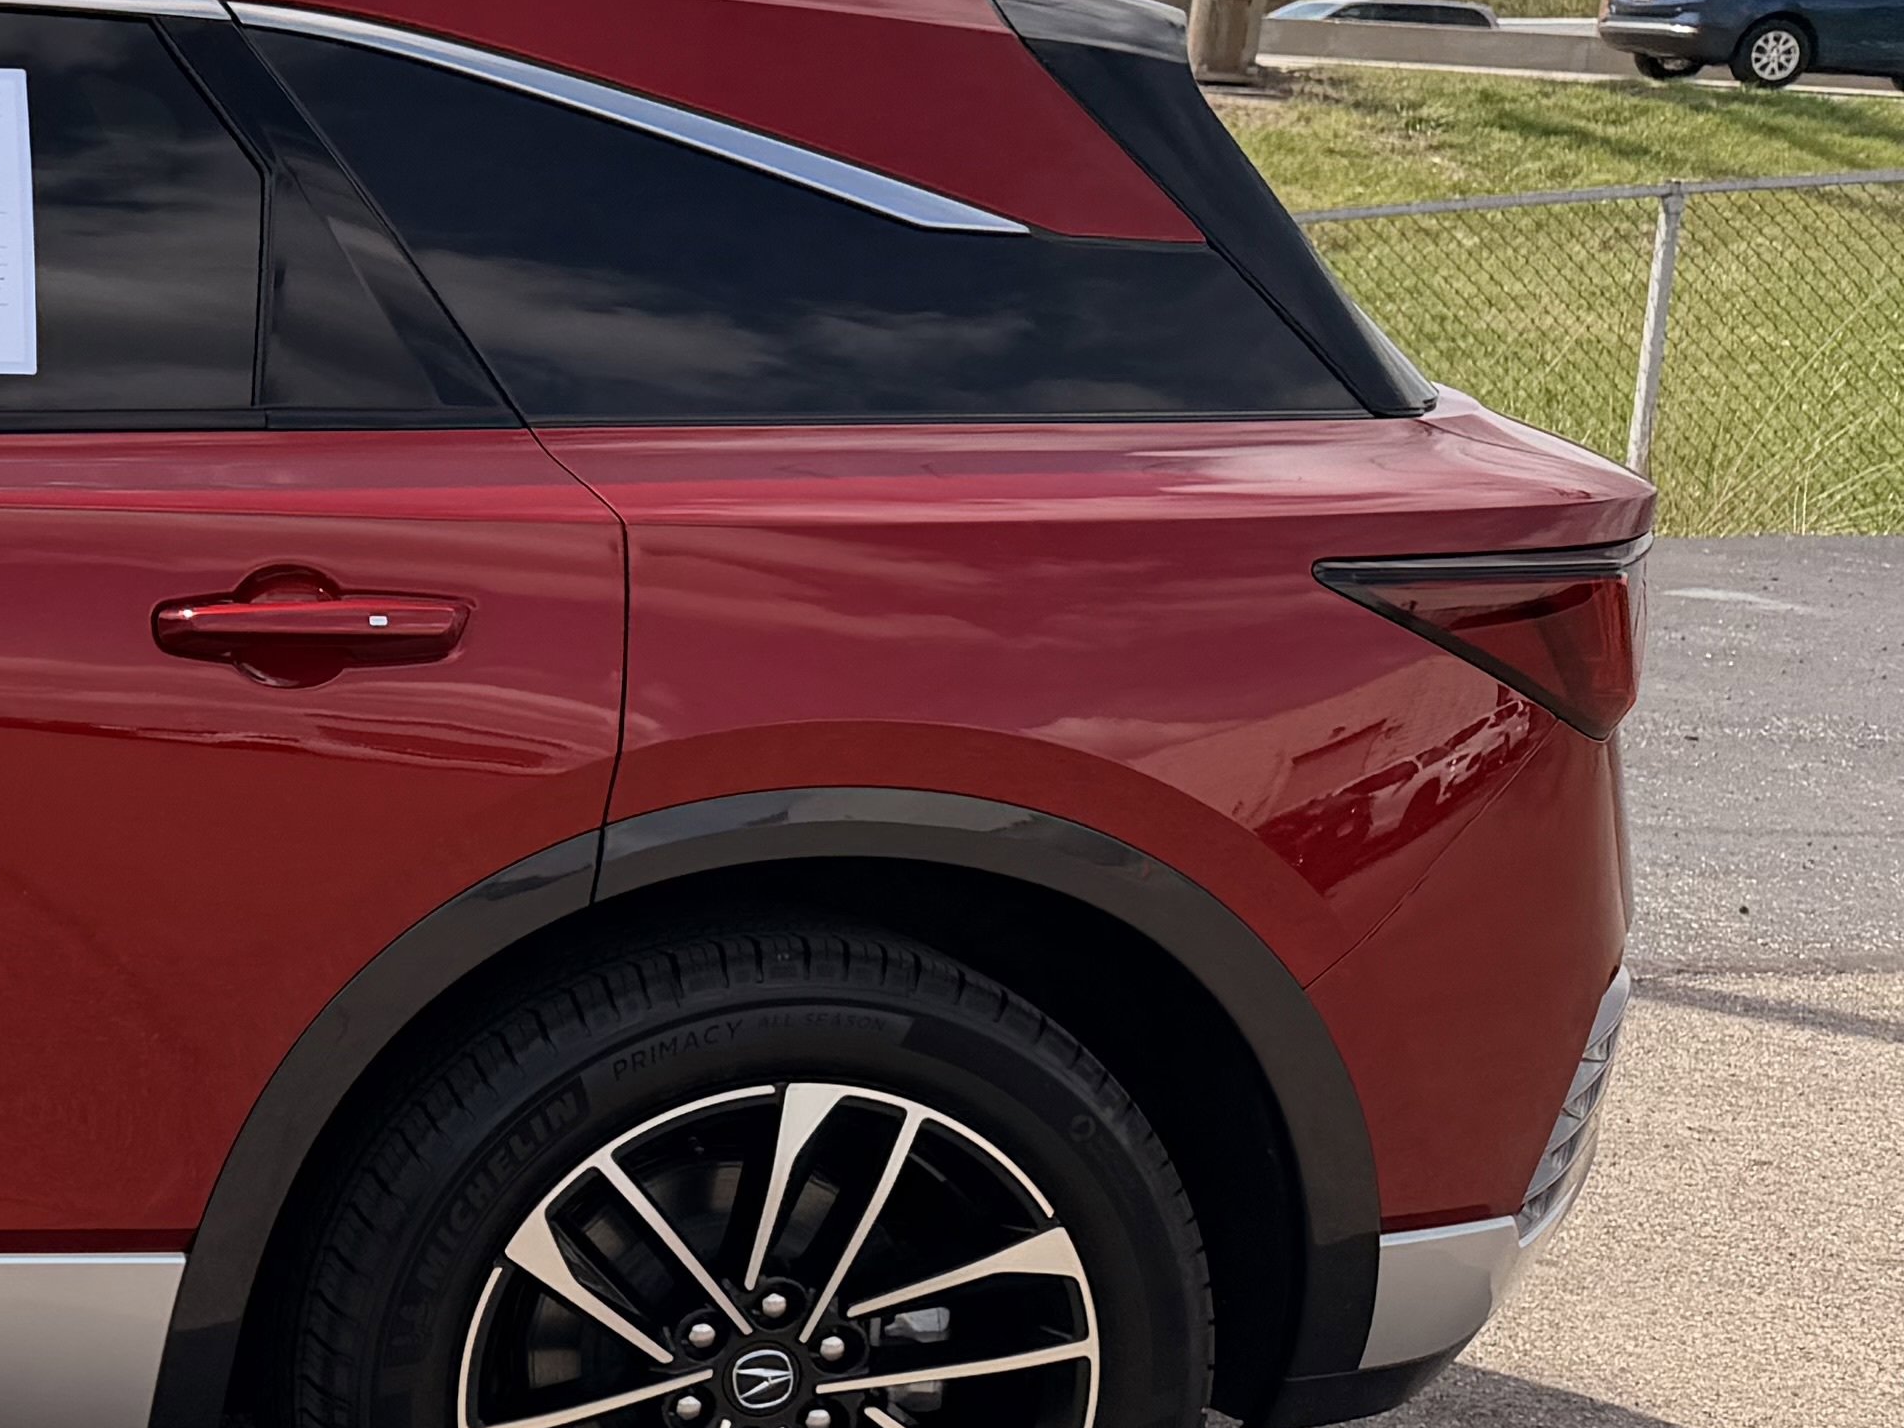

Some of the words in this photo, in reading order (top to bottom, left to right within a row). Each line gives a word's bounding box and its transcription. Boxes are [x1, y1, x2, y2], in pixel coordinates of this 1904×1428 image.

[612, 1018, 744, 1082] PRIMACY
[804, 1012, 888, 1032] SEASON
[414, 1090, 580, 1291] MICHELIN
